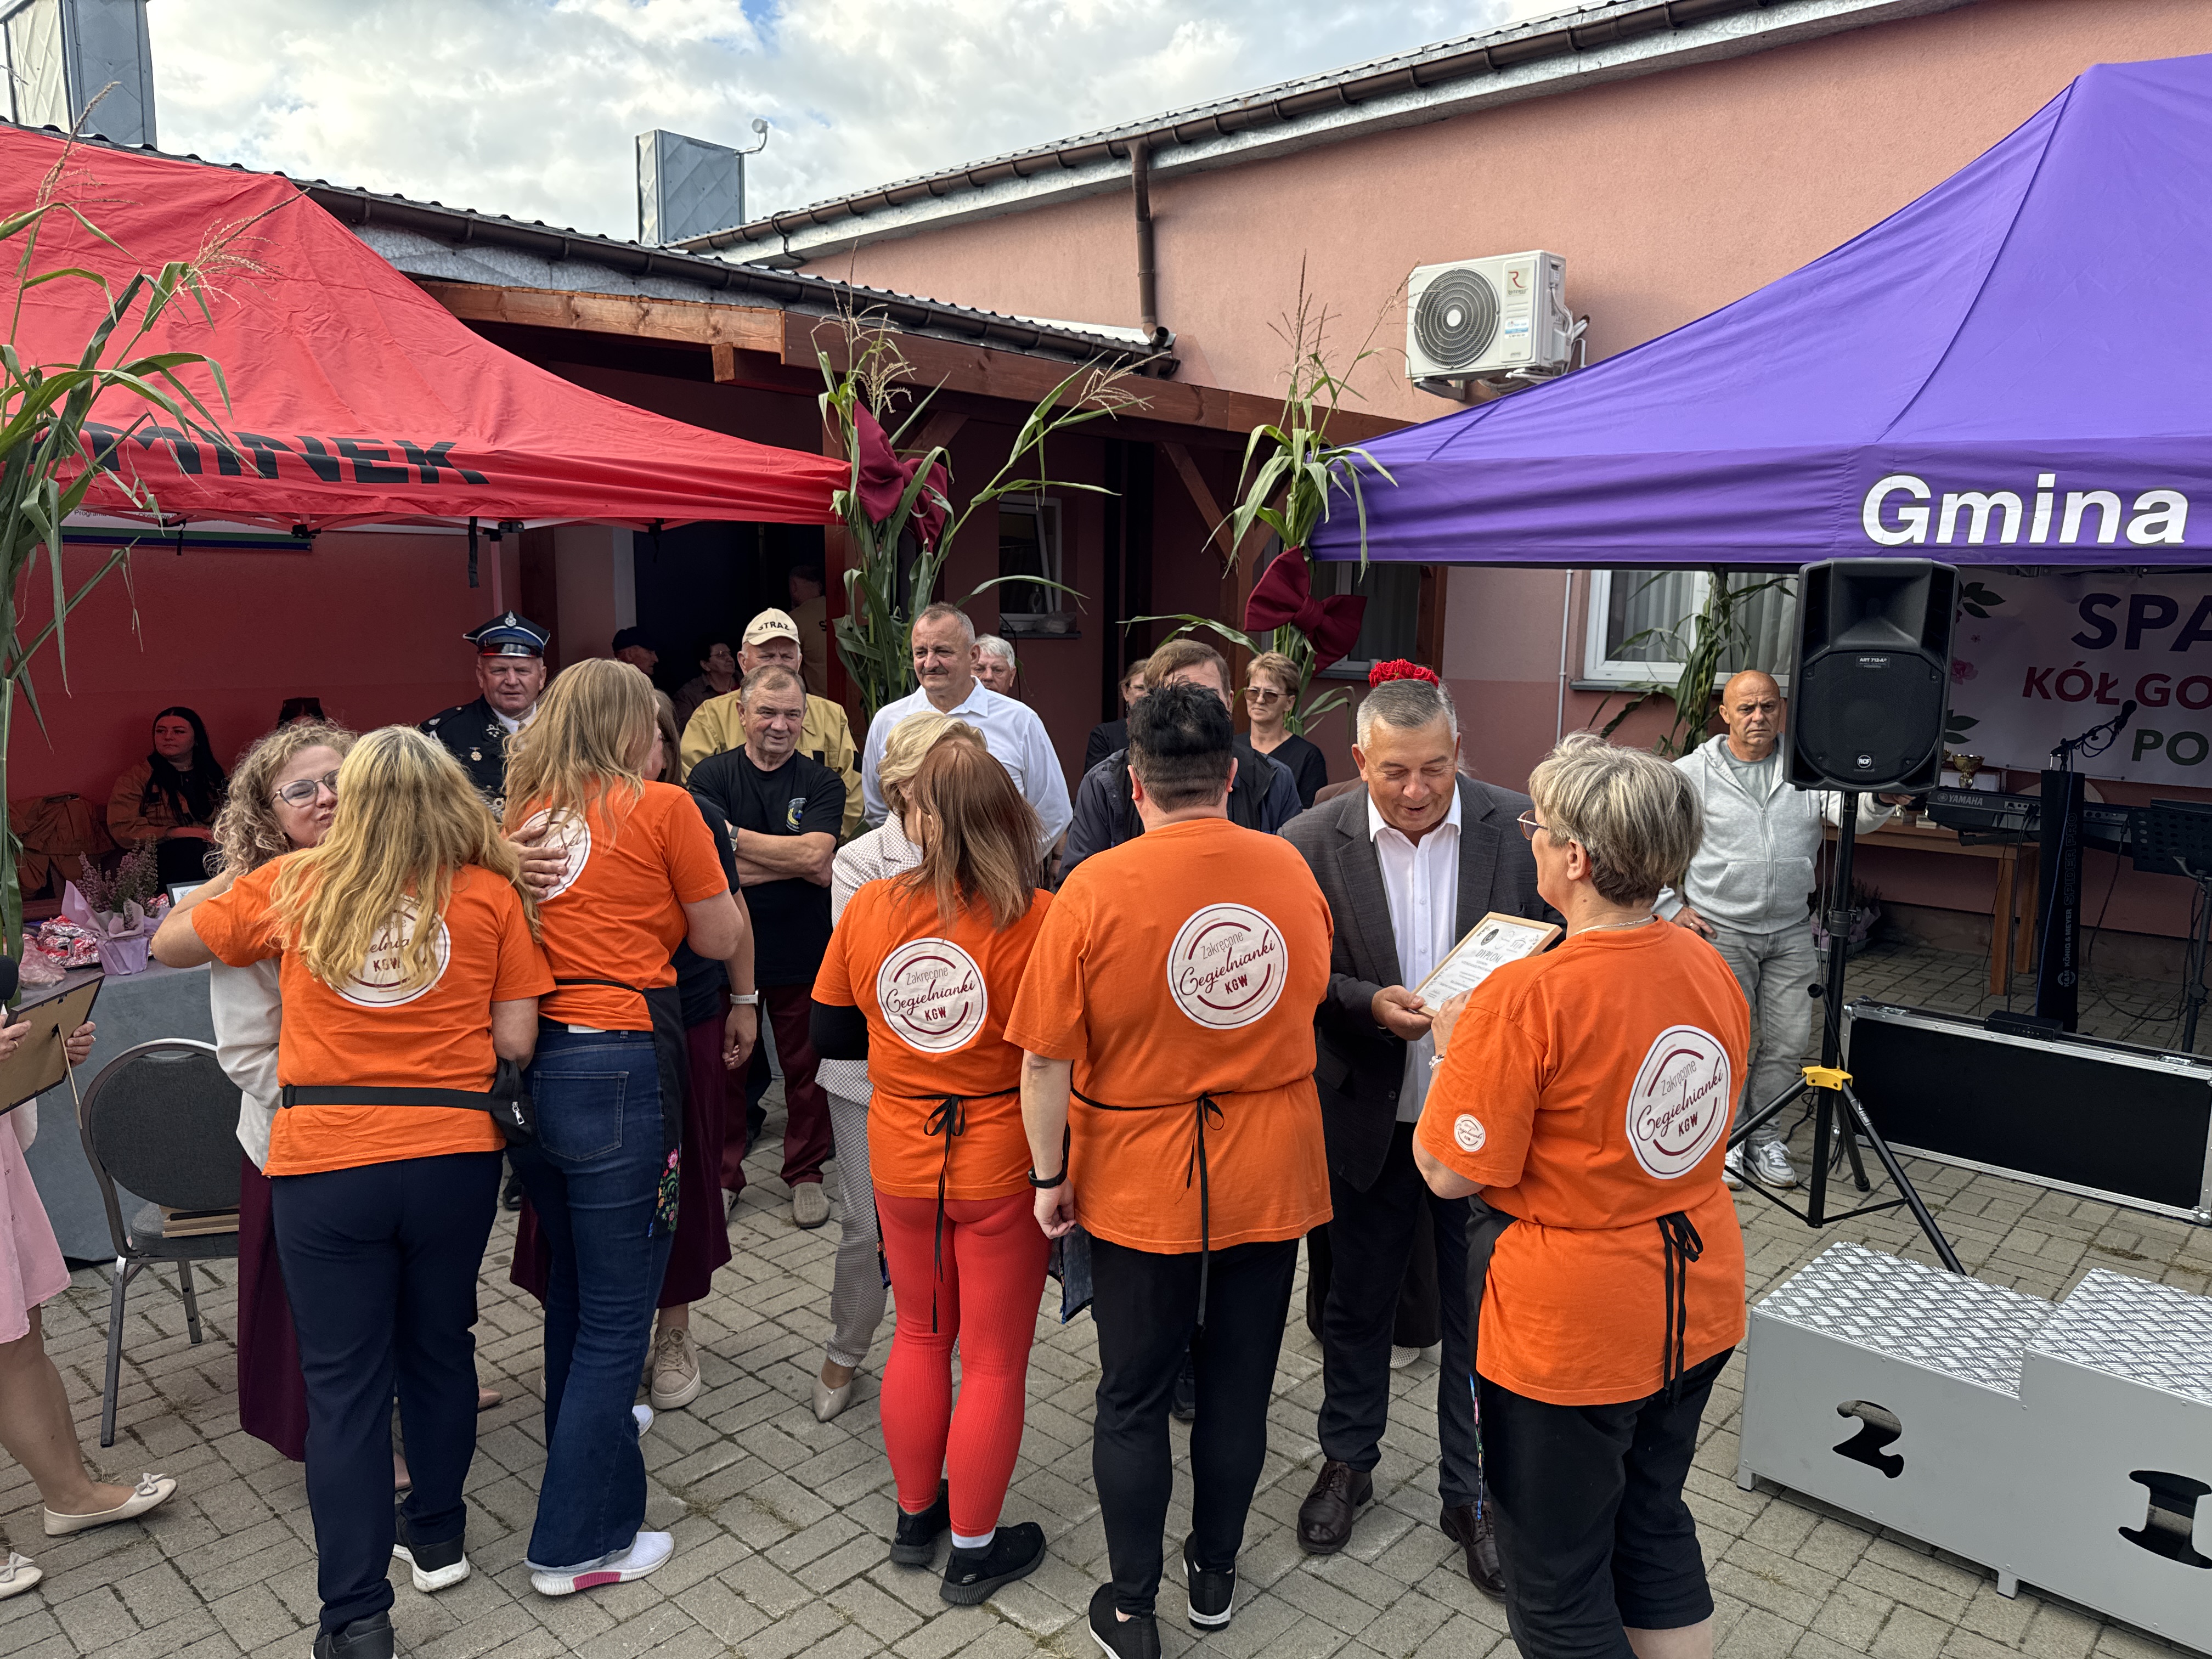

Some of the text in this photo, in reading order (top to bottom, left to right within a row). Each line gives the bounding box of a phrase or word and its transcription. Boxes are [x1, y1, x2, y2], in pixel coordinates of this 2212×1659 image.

[1862, 473, 2189, 546] Gmina
[2022, 661, 2120, 705] KÓŁ
[2131, 729, 2209, 766] PO
[1948, 794, 1983, 806] YAMAHA
[2064, 812, 2078, 905] SPIDER PRO
[1200, 932, 1244, 960] Zakręcone
[906, 967, 949, 985] Zakręcone
[1224, 974, 1248, 995] KGW
[924, 1006, 946, 1022] KGW
[1661, 1060, 1697, 1096] Zakręcone
[1679, 1111, 1699, 1137] KGW
[1832, 1400, 1904, 1479] 2
